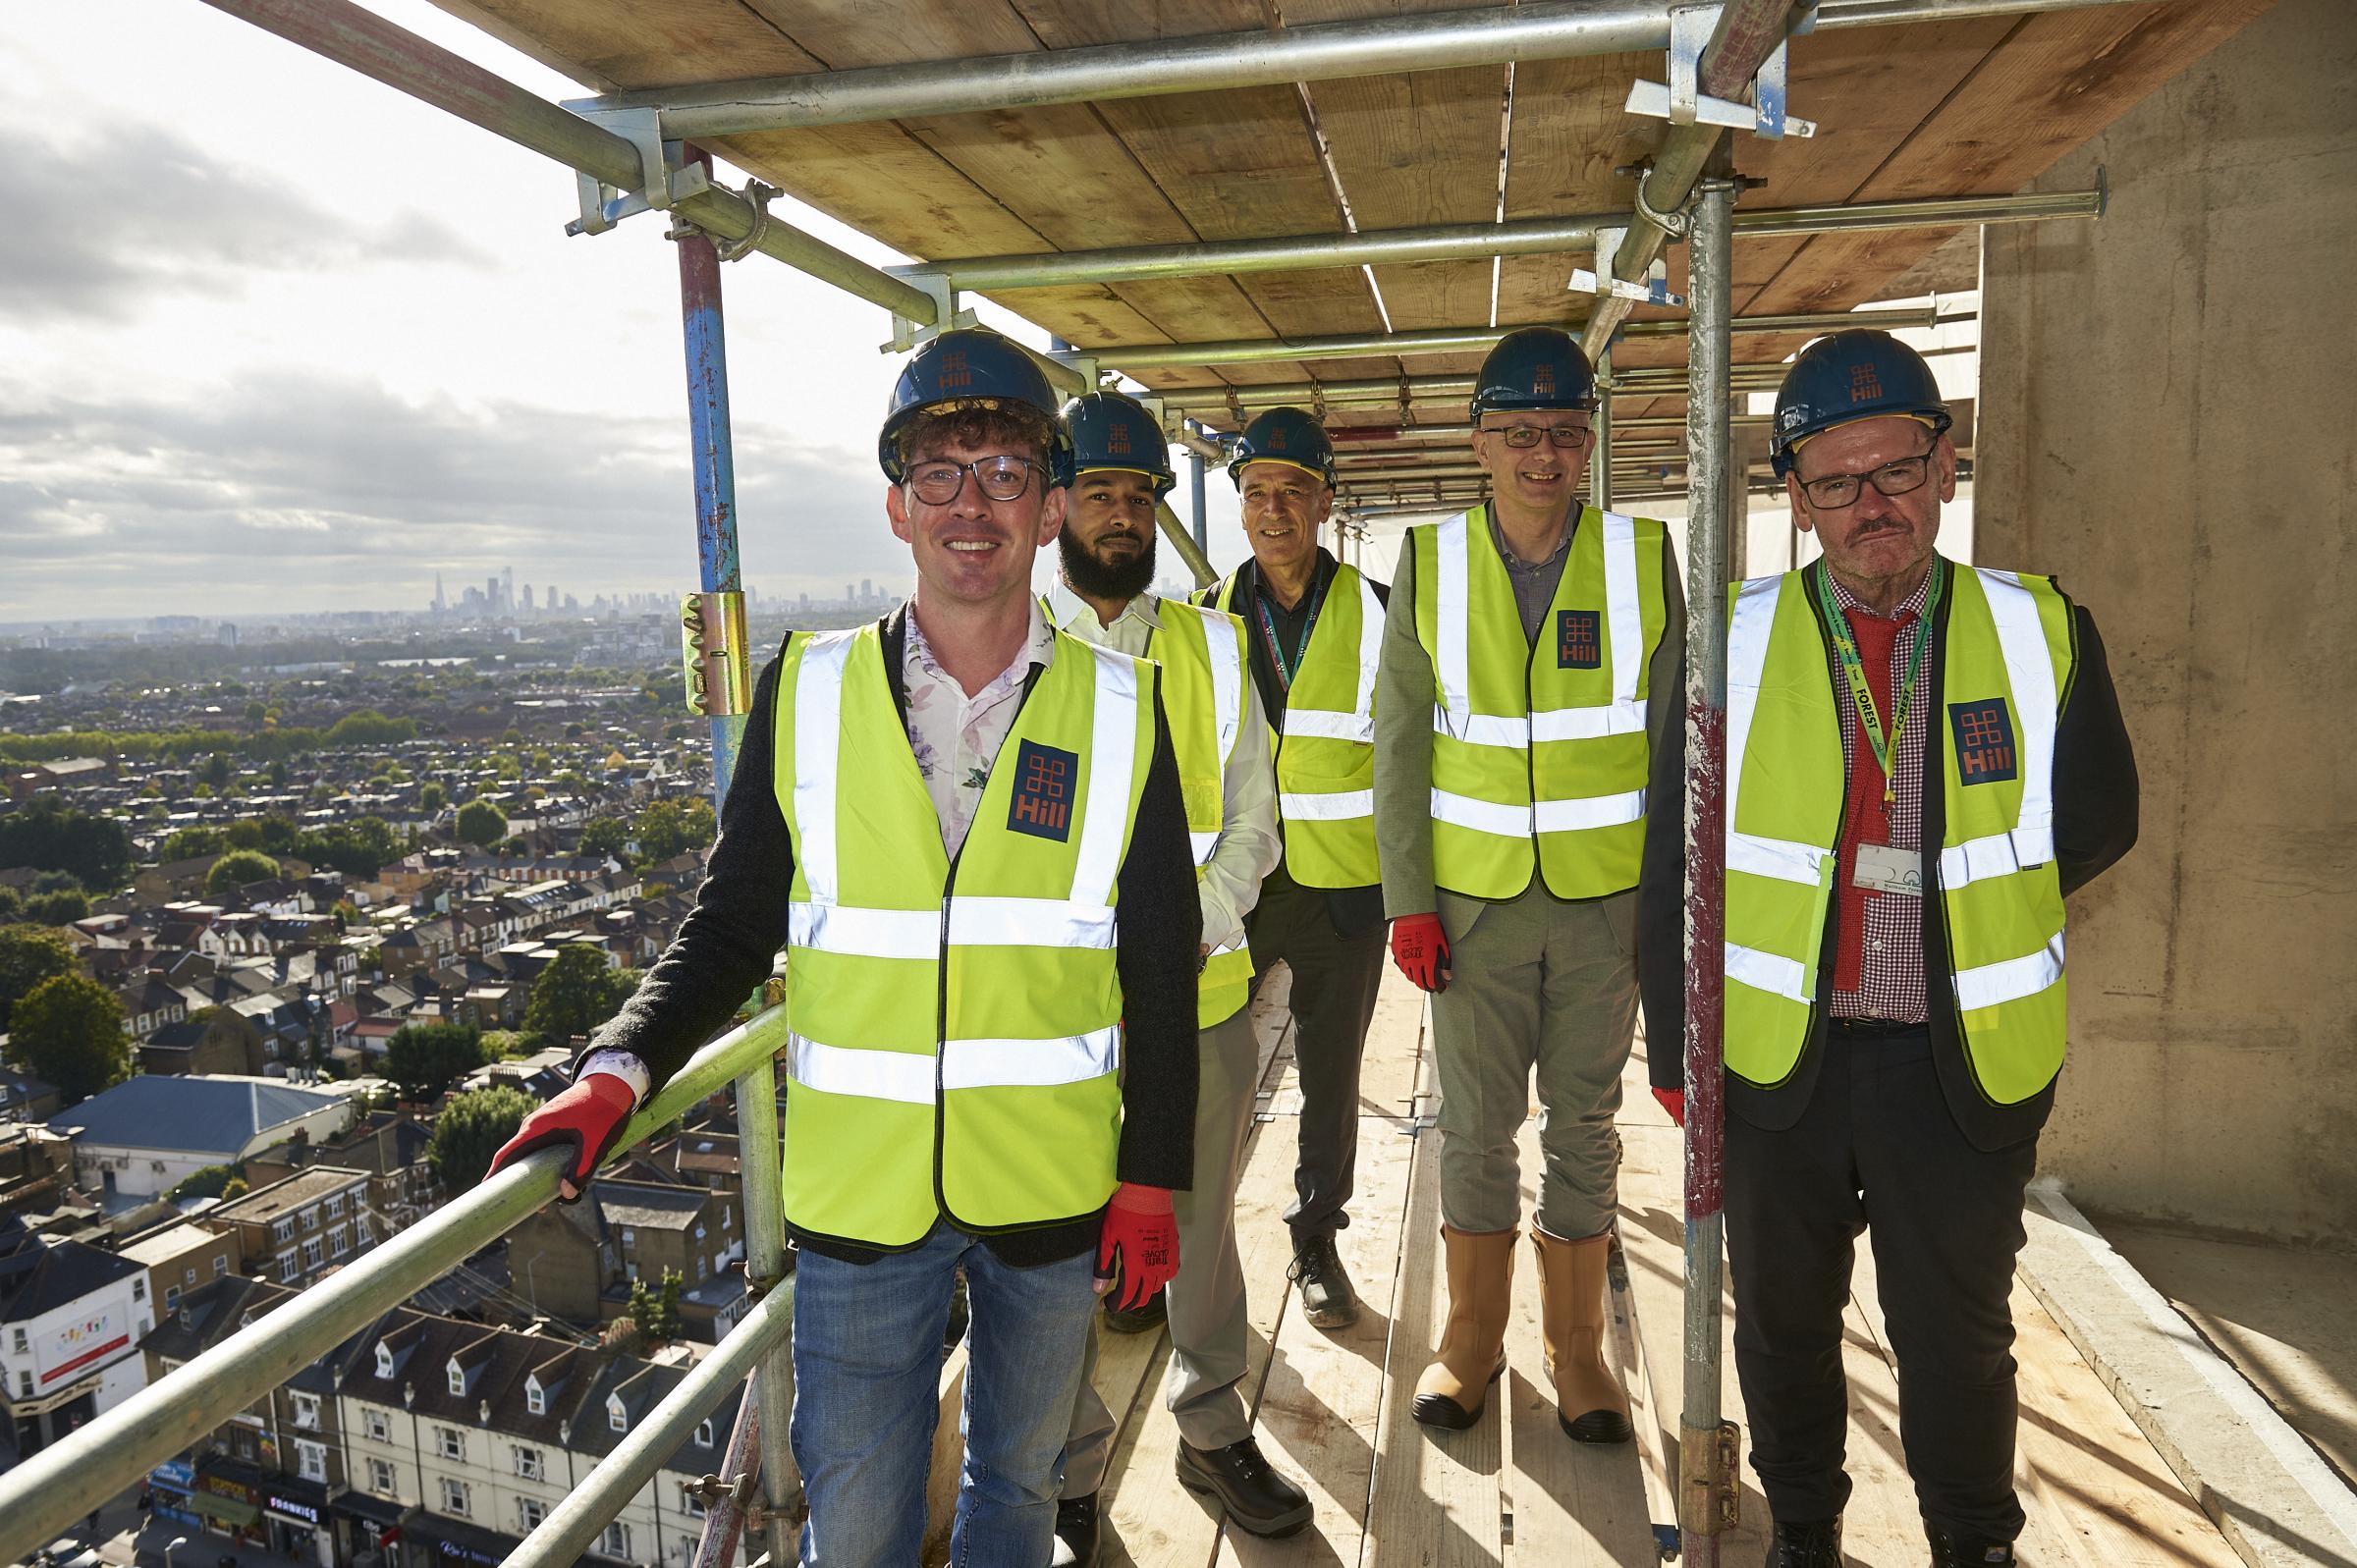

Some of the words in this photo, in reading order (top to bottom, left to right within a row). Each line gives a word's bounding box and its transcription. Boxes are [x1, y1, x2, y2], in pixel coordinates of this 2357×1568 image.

[938, 373, 971, 389] Hill
[1533, 382, 1556, 394] Hill
[1851, 384, 1883, 402] Hill
[1108, 441, 1130, 454] Hill
[1268, 439, 1288, 449] Hill
[1562, 644, 1596, 661] Hill
[1856, 688, 1879, 730] FOREST
[1894, 687, 1911, 730] FOREST
[1963, 746, 2011, 775] Hill
[1015, 793, 1066, 829] Hill
[270, 1496, 318, 1523] FRANKIES
